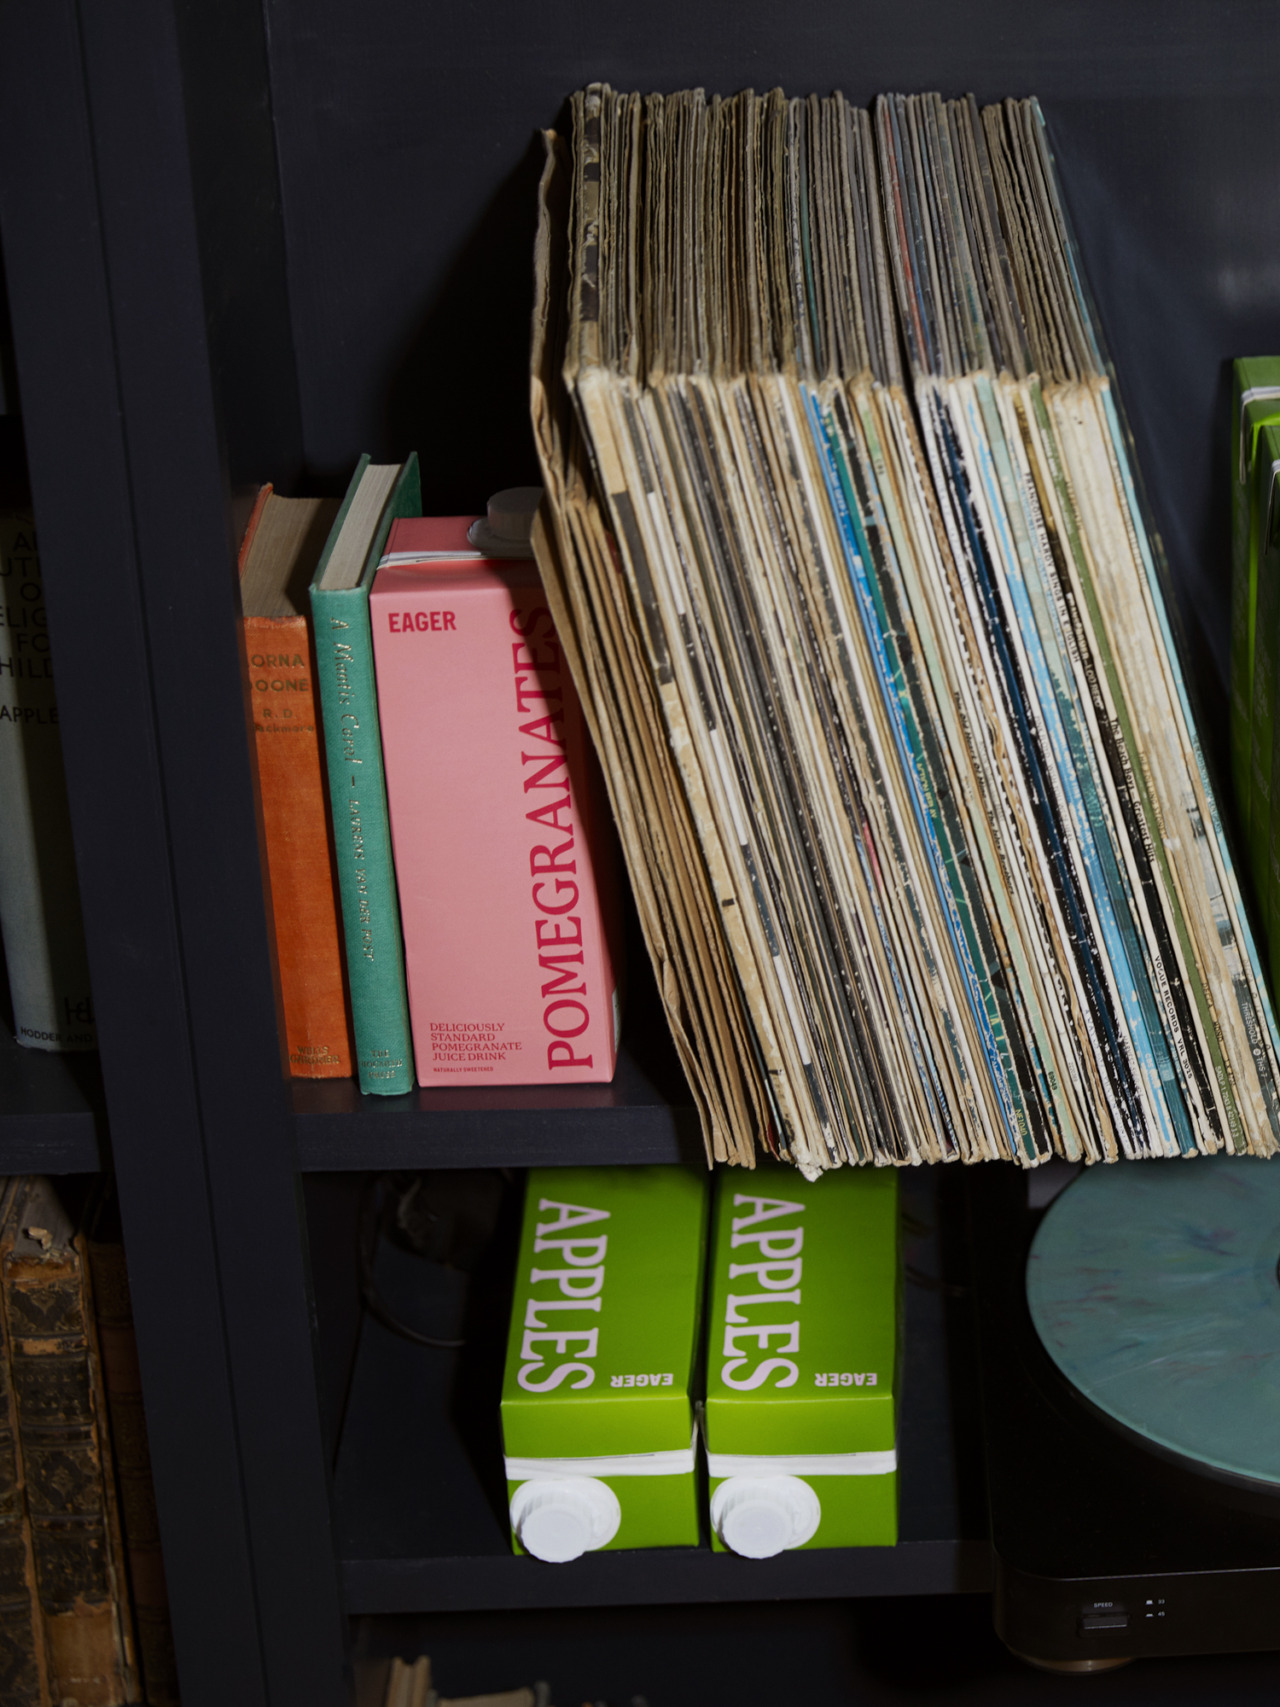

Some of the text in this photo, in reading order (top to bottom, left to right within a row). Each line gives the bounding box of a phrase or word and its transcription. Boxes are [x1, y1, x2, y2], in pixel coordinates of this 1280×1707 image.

[389, 611, 457, 633] EAGER
[250, 679, 310, 692] OONE
[330, 617, 375, 962] A Mantis Carol LAURENS VAN DER POST
[1117, 737, 1130, 765] Beach
[1125, 768, 1137, 790] Boys
[1133, 801, 1151, 839] Greatest
[1145, 843, 1157, 864] Hits
[509, 606, 592, 1071] POMEGRANATES
[1164, 990, 1179, 1033] RECORDS
[430, 1022, 505, 1032] DELICIOUSLY
[430, 1033, 496, 1042] STANDARD
[1241, 1001, 1257, 1043] THRESHOLD
[1255, 1057, 1265, 1072] THS
[432, 1042, 522, 1052] POMEGRANATE
[433, 1052, 506, 1062] JUICE DRINK
[517, 1198, 612, 1393] APPLES
[721, 1193, 806, 1392] APPLES
[611, 1373, 675, 1388] EAGER
[815, 1373, 878, 1388] EAGER
